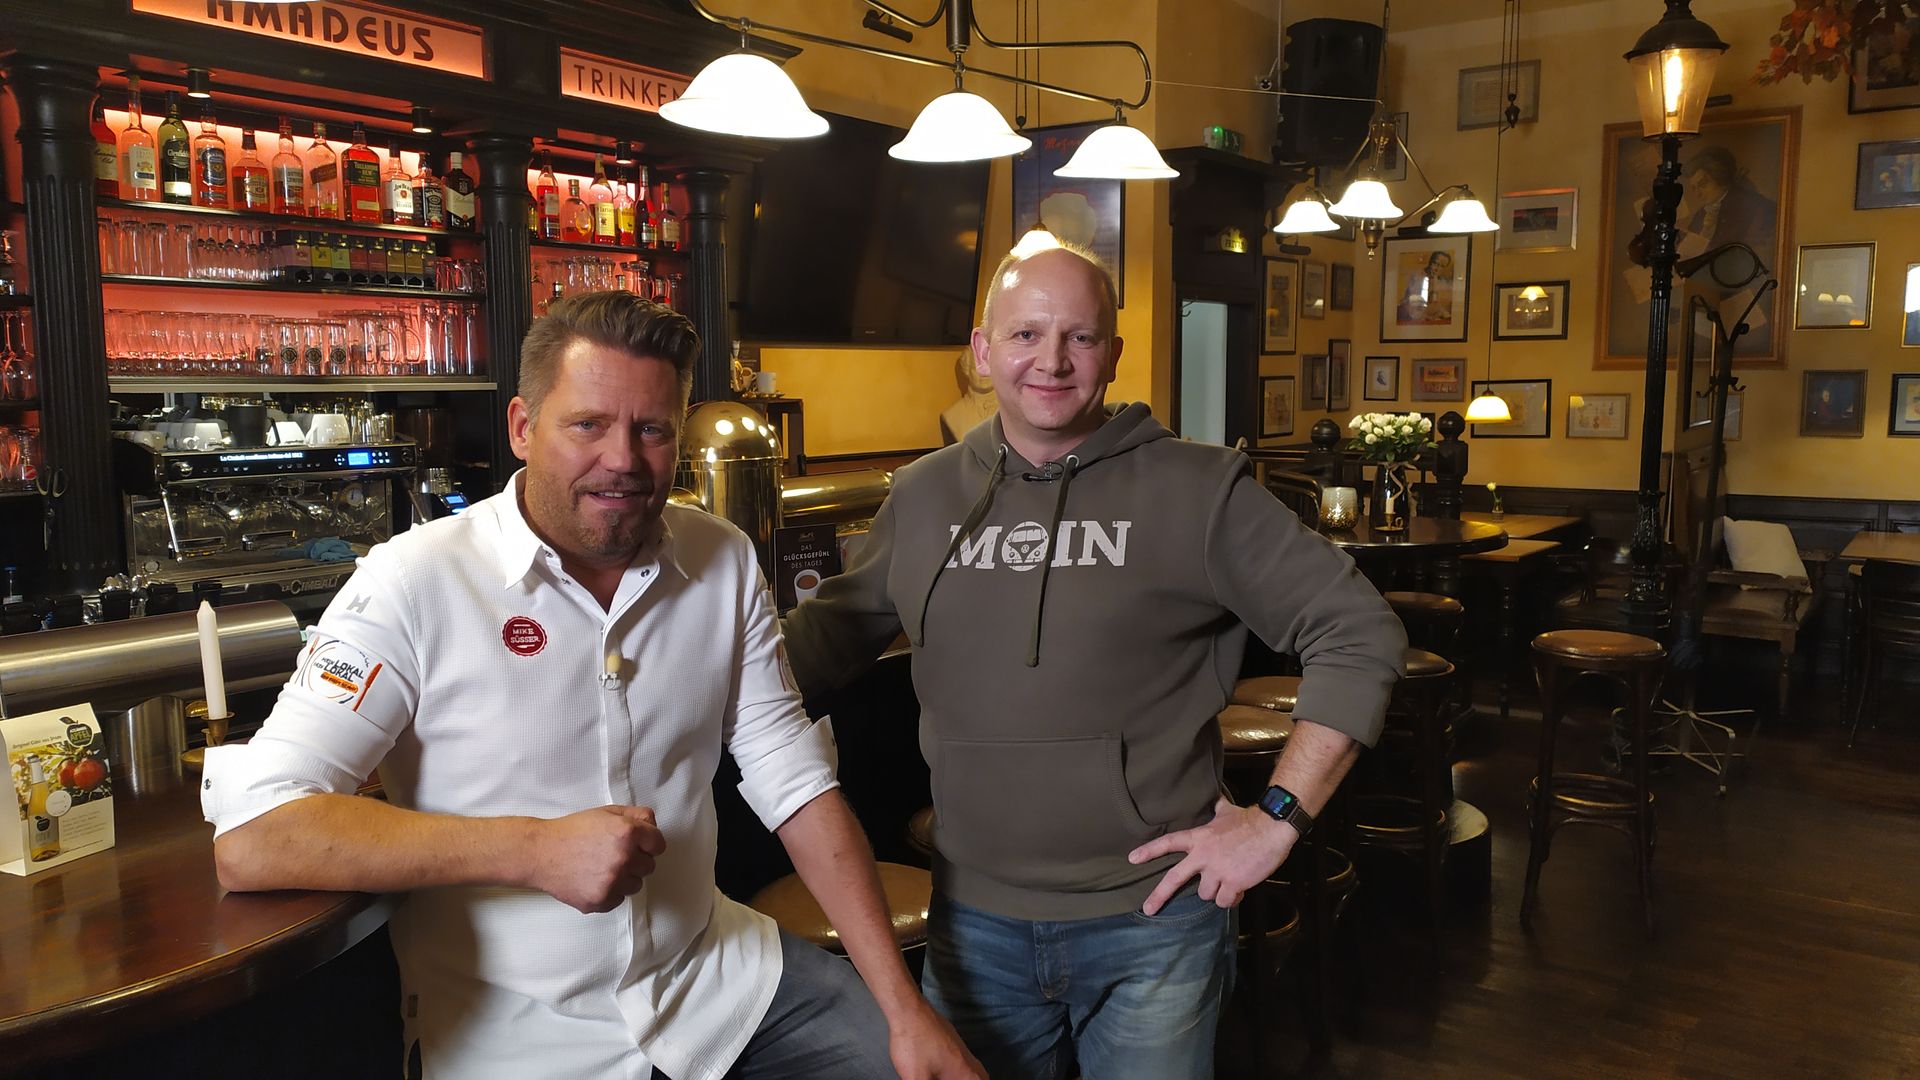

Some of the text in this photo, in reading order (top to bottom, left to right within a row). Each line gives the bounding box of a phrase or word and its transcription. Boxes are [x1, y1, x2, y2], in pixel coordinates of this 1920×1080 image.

[201, 1, 434, 62] AMADEUS
[783, 550, 830, 562] GLÜCKSGEFÜHL
[291, 574, 340, 595] CIMBALI
[323, 662, 354, 682] LOKAL
[334, 659, 364, 680] LOKAL
